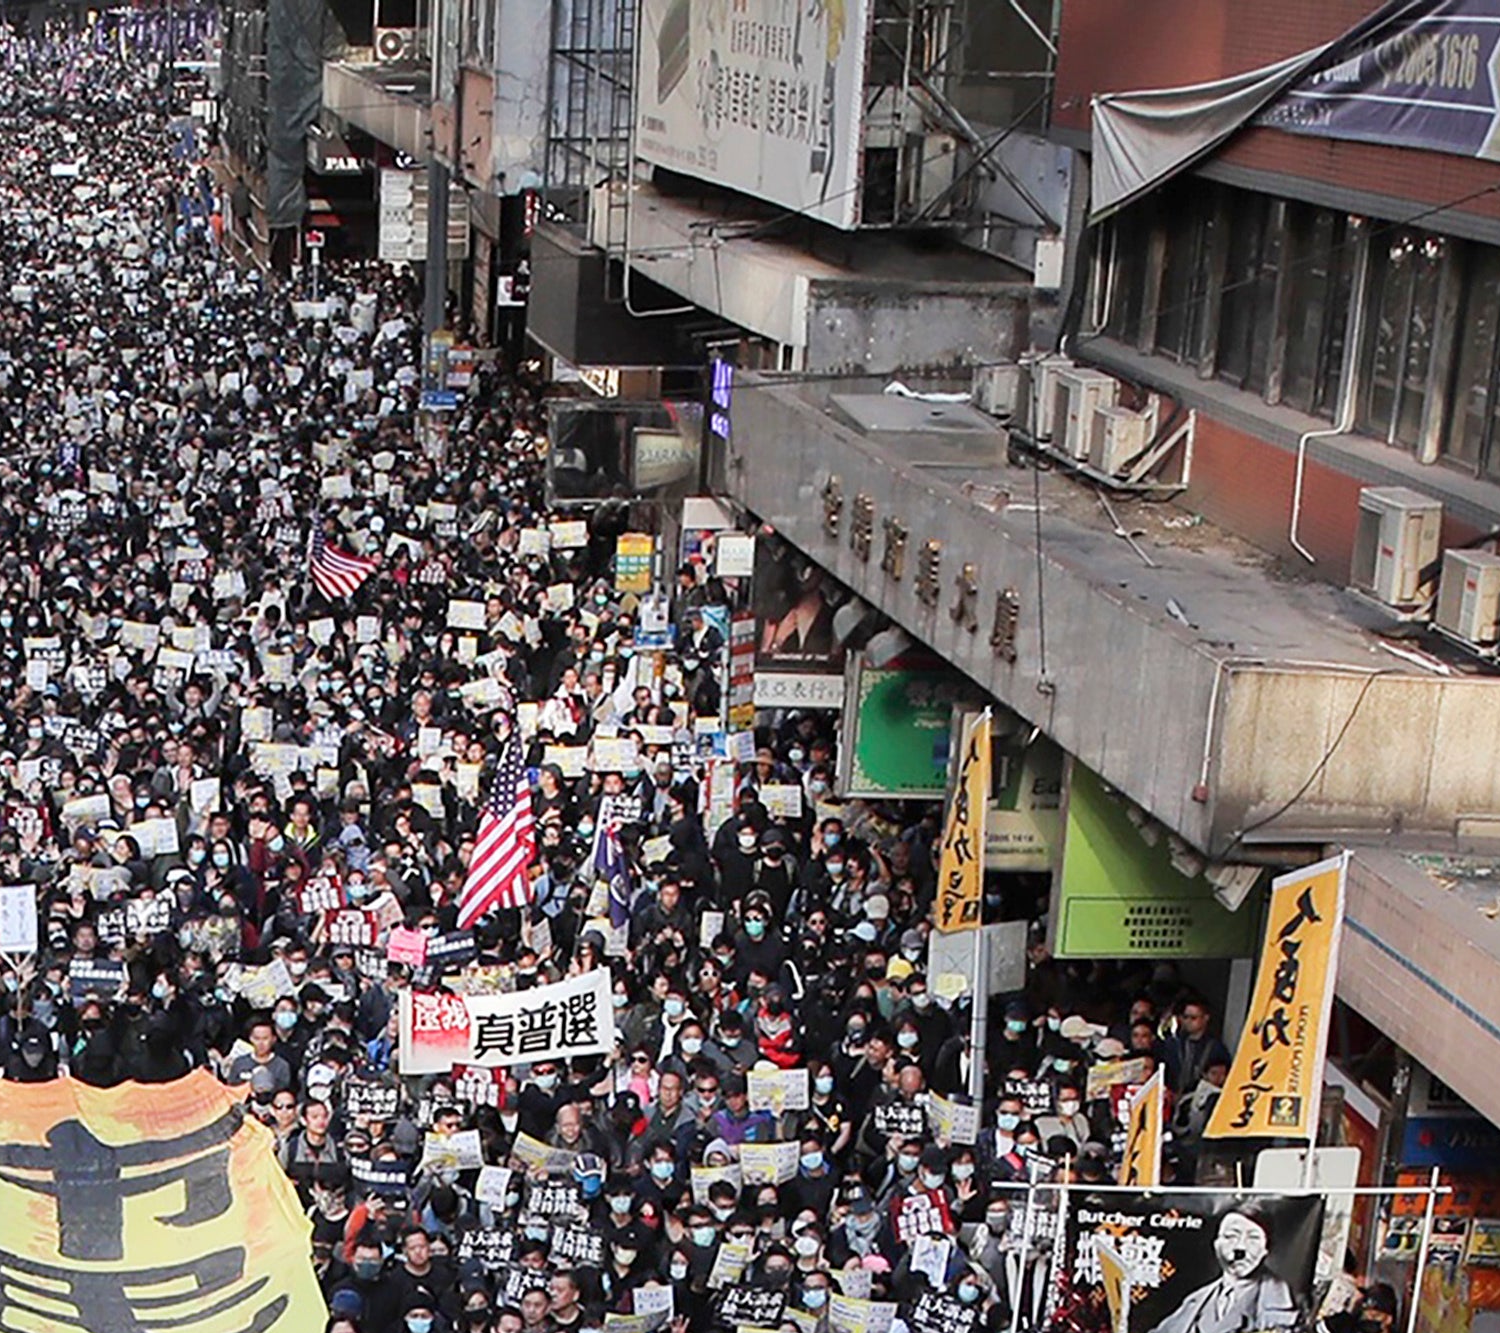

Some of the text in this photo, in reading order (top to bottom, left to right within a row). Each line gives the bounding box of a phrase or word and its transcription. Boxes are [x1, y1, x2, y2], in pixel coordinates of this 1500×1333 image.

[476, 993, 598, 1057] 真普選
[1078, 1210, 1203, 1229] Butcher Carrie
